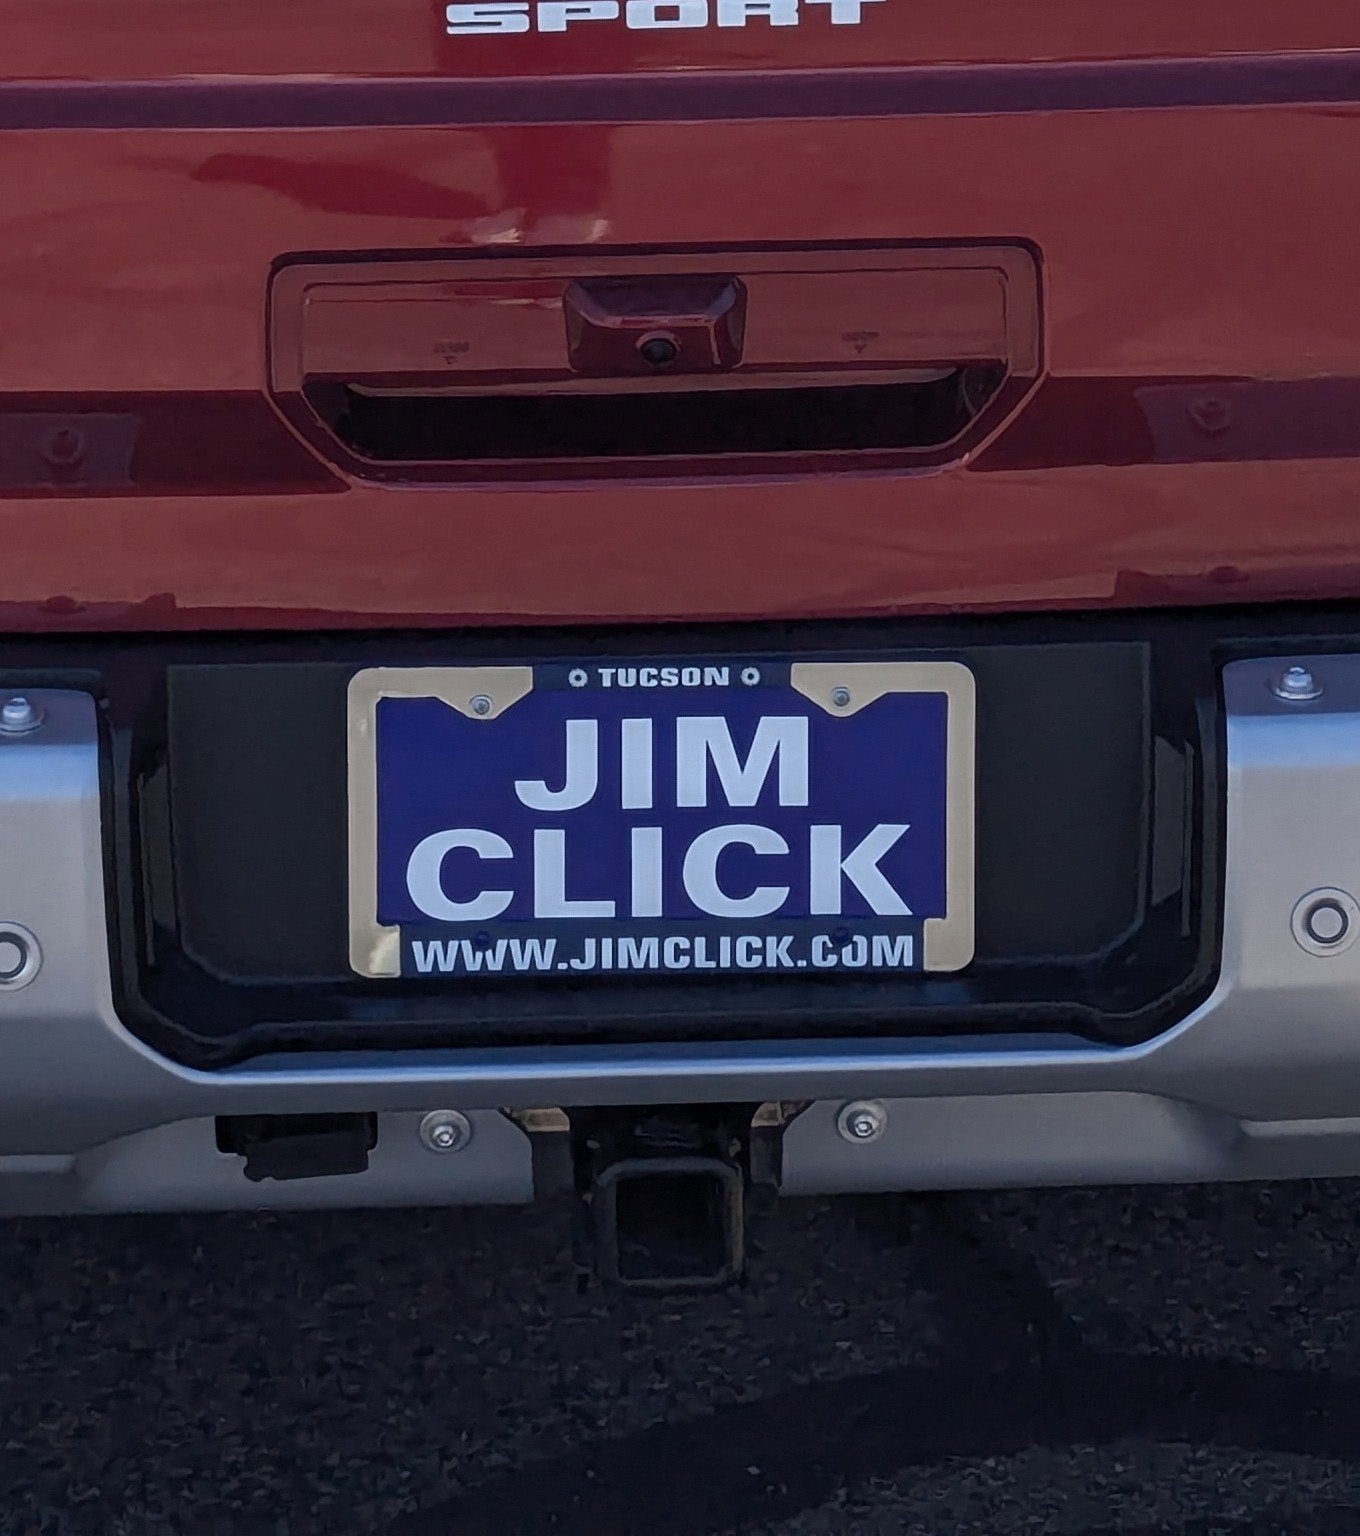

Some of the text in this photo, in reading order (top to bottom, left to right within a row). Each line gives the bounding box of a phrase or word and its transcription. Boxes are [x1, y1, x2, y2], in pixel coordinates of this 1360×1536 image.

[598, 666, 730, 688] TUCSON
[513, 715, 810, 811] JIM
[405, 822, 912, 922] CLICK
[410, 934, 914, 973] WWW.JIMCLICK.COM
